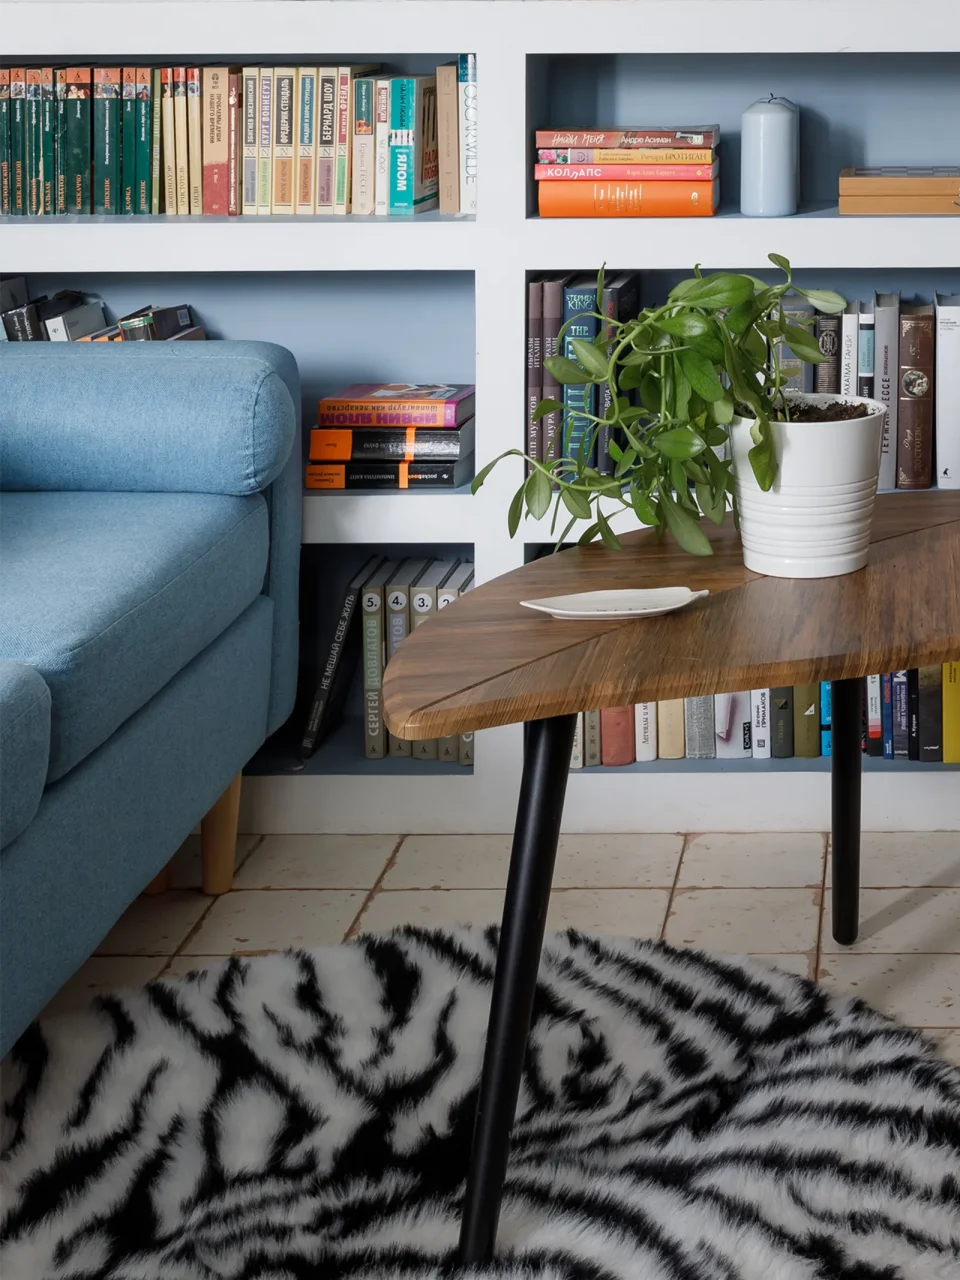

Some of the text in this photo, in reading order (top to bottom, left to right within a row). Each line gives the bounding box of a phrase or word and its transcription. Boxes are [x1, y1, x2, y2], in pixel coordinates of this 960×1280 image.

[246, 80, 254, 118] БЖЕЗИНСКИЙ
[340, 85, 348, 110] ФРЕЙД
[399, 83, 407, 127] ПАЛАЧ ЛЮБВИ
[260, 80, 270, 144] КУРТ ВОННЕГУТ
[280, 79, 289, 144] ФРЕДЕРИК СТЕНДАЛЬ
[322, 82, 333, 141] БЕРНАРД ШОУ
[464, 84, 477, 138] OSCAR
[302, 123, 310, 144] АРКАДИЙ
[621, 136, 672, 144] Андре Асиман
[465, 138, 477, 186] WILDE
[665, 152, 707, 161] БРОТИГАН
[397, 154, 407, 191] ЯЛОМ
[547, 168, 603, 179] КОЛЛАПС
[565, 294, 596, 302] STEPHEN
[568, 301, 593, 310] KING
[570, 325, 589, 336] THE
[320, 412, 438, 425] ИРВИН ЯЛОМ
[326, 404, 369, 412] лекарство
[388, 403, 438, 412] Шопенгауэр
[547, 395, 556, 437] МУРАВ
[366, 597, 377, 608] 5.
[392, 596, 402, 606] 4.
[418, 597, 428, 608] 3.
[320, 594, 355, 690] НЕ МЕШАЙ СЕБЕ ЖИТЬ
[392, 618, 403, 648] АТОВ
[367, 619, 379, 736] СЕРГЕЙ ДОВЛАТОВ
[642, 717, 650, 745] Легенды
